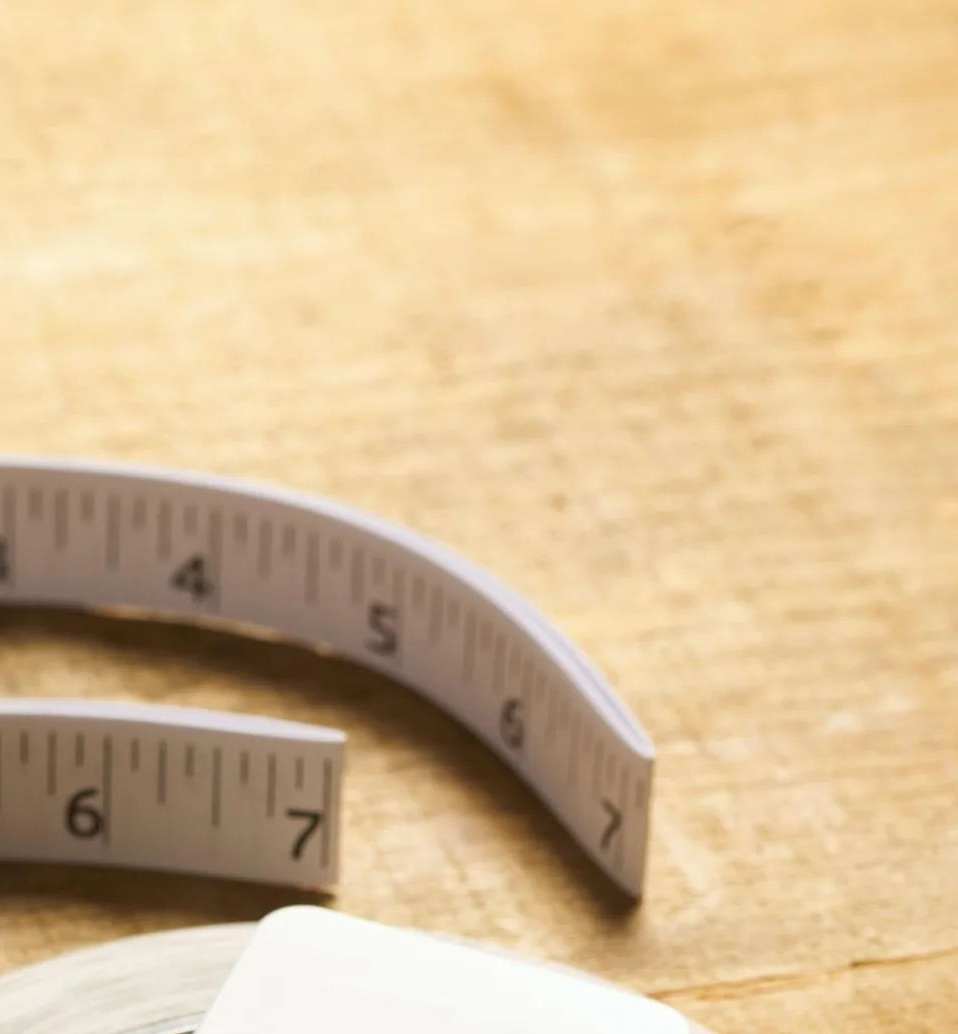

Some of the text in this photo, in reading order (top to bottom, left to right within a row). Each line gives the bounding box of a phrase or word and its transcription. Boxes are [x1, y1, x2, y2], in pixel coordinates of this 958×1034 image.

[170, 553, 214, 601] 4
[365, 604, 397, 658] 5
[499, 698, 525, 751] 6
[598, 800, 623, 851] 7
[63, 787, 105, 840] 6
[285, 808, 323, 860] 7
